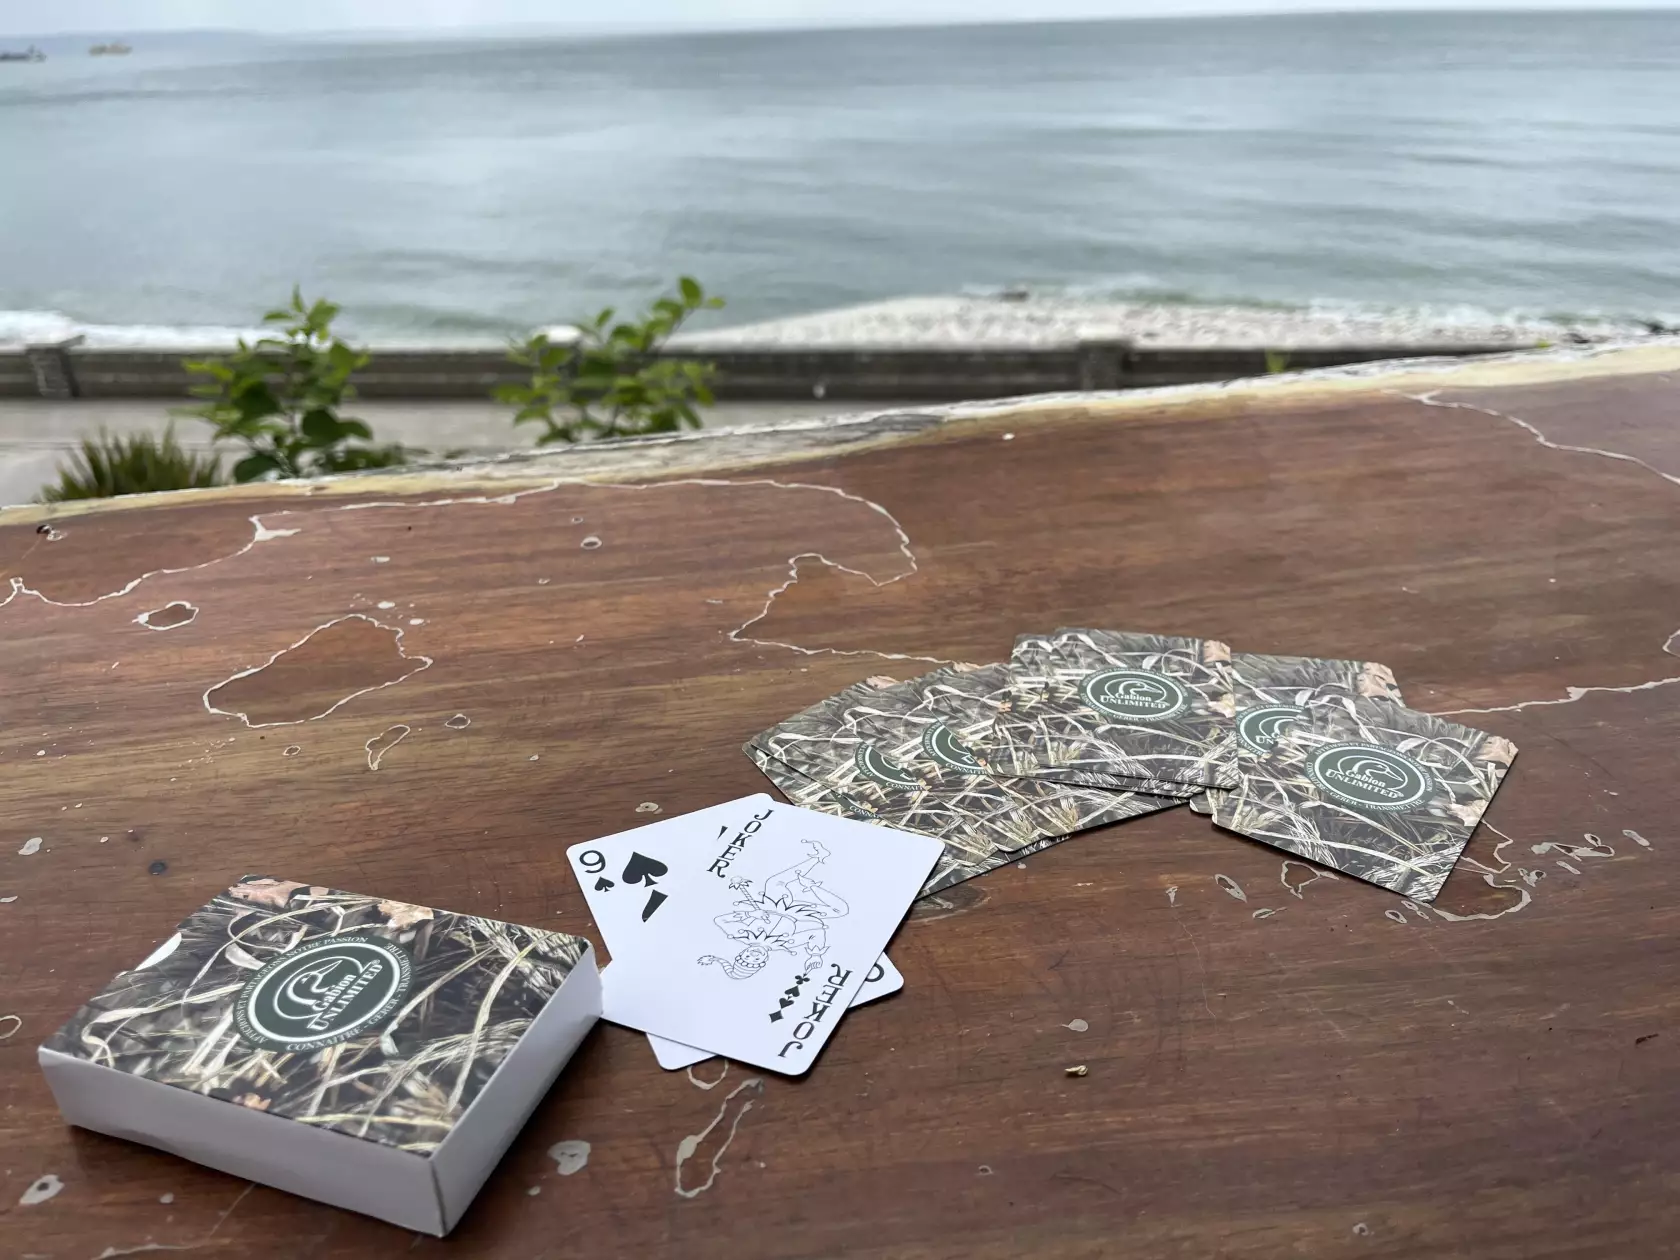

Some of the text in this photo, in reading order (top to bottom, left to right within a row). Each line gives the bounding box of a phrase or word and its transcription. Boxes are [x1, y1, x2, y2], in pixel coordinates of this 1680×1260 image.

[1115, 692, 1152, 702] Gabion
[1345, 769, 1386, 788] Gabion
[706, 808, 775, 879] JOKER
[579, 849, 606, 874] 9
[311, 973, 357, 1012] Gabion
[777, 963, 853, 1058] JOKER
